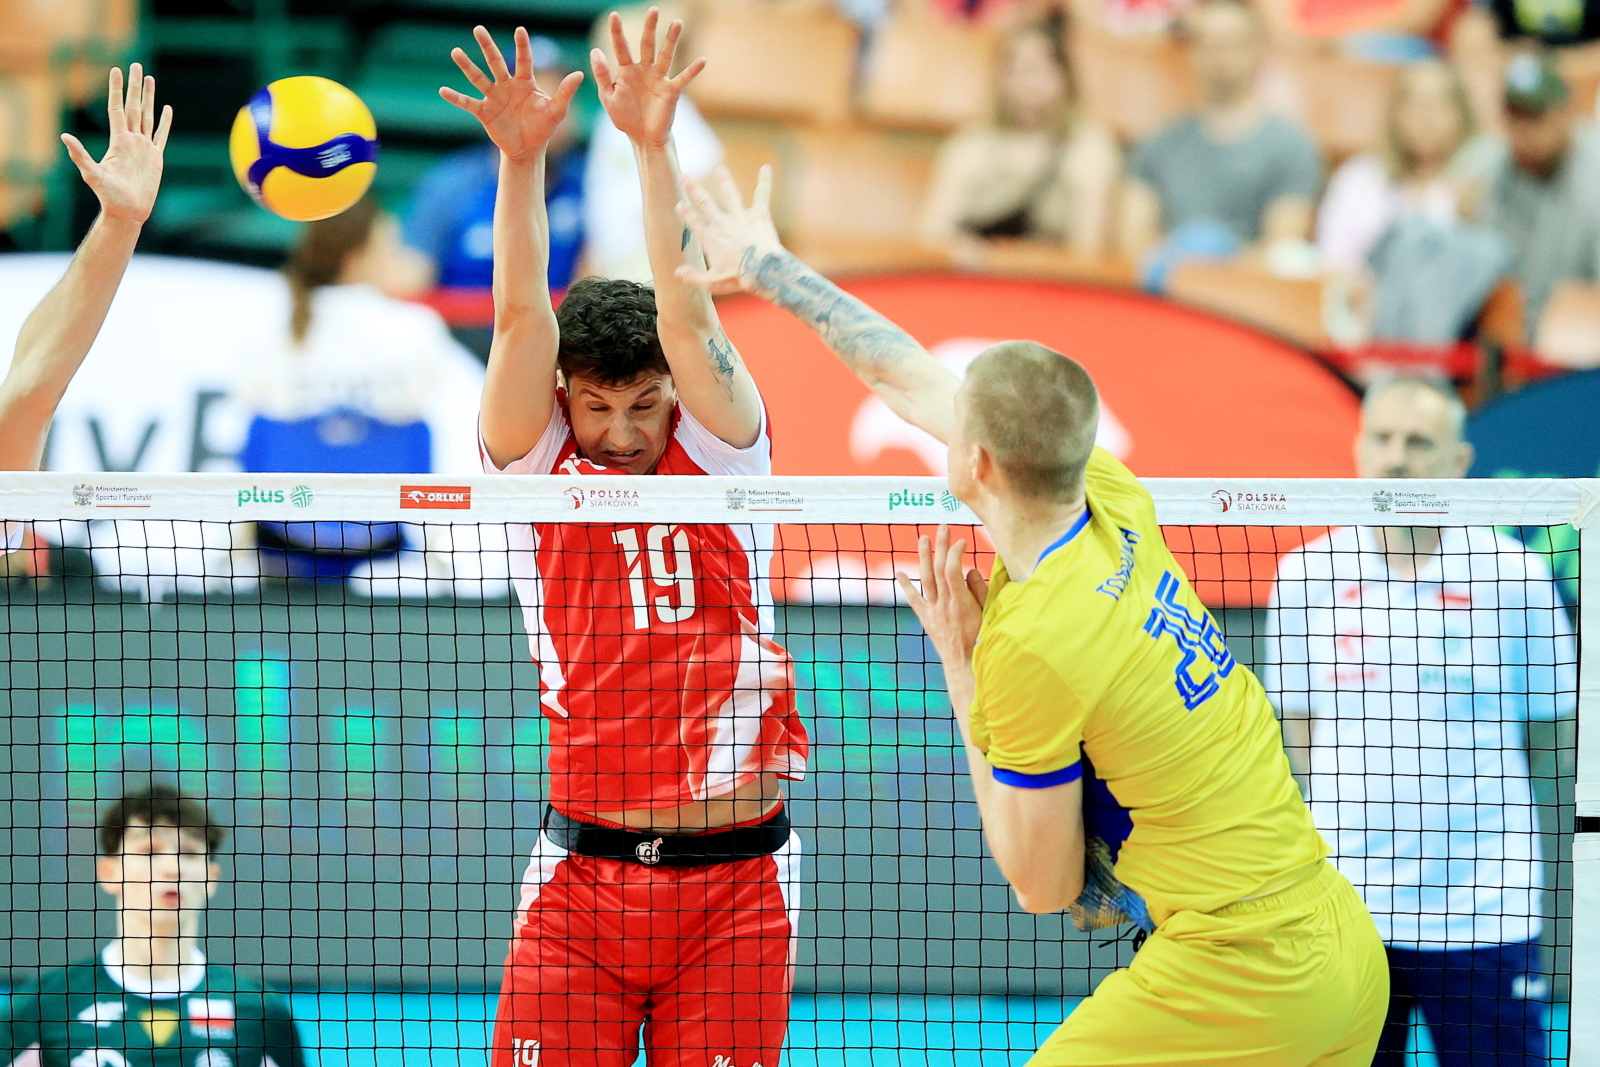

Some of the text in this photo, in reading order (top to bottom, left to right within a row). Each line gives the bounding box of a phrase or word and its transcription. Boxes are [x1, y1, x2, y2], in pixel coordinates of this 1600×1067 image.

[238, 486, 285, 507] plus
[427, 493, 464, 502] ORLEN
[590, 490, 639, 498] POLSKA
[1237, 493, 1287, 502] POLSKA
[590, 499, 639, 508] SIATKÓWKA
[889, 489, 935, 510] plus
[1421, 500, 1450, 508] Turystyki
[1237, 503, 1287, 511] SIATKÓWKA
[611, 524, 696, 630] 19
[1142, 569, 1237, 711] 26
[511, 1037, 540, 1067] 19
